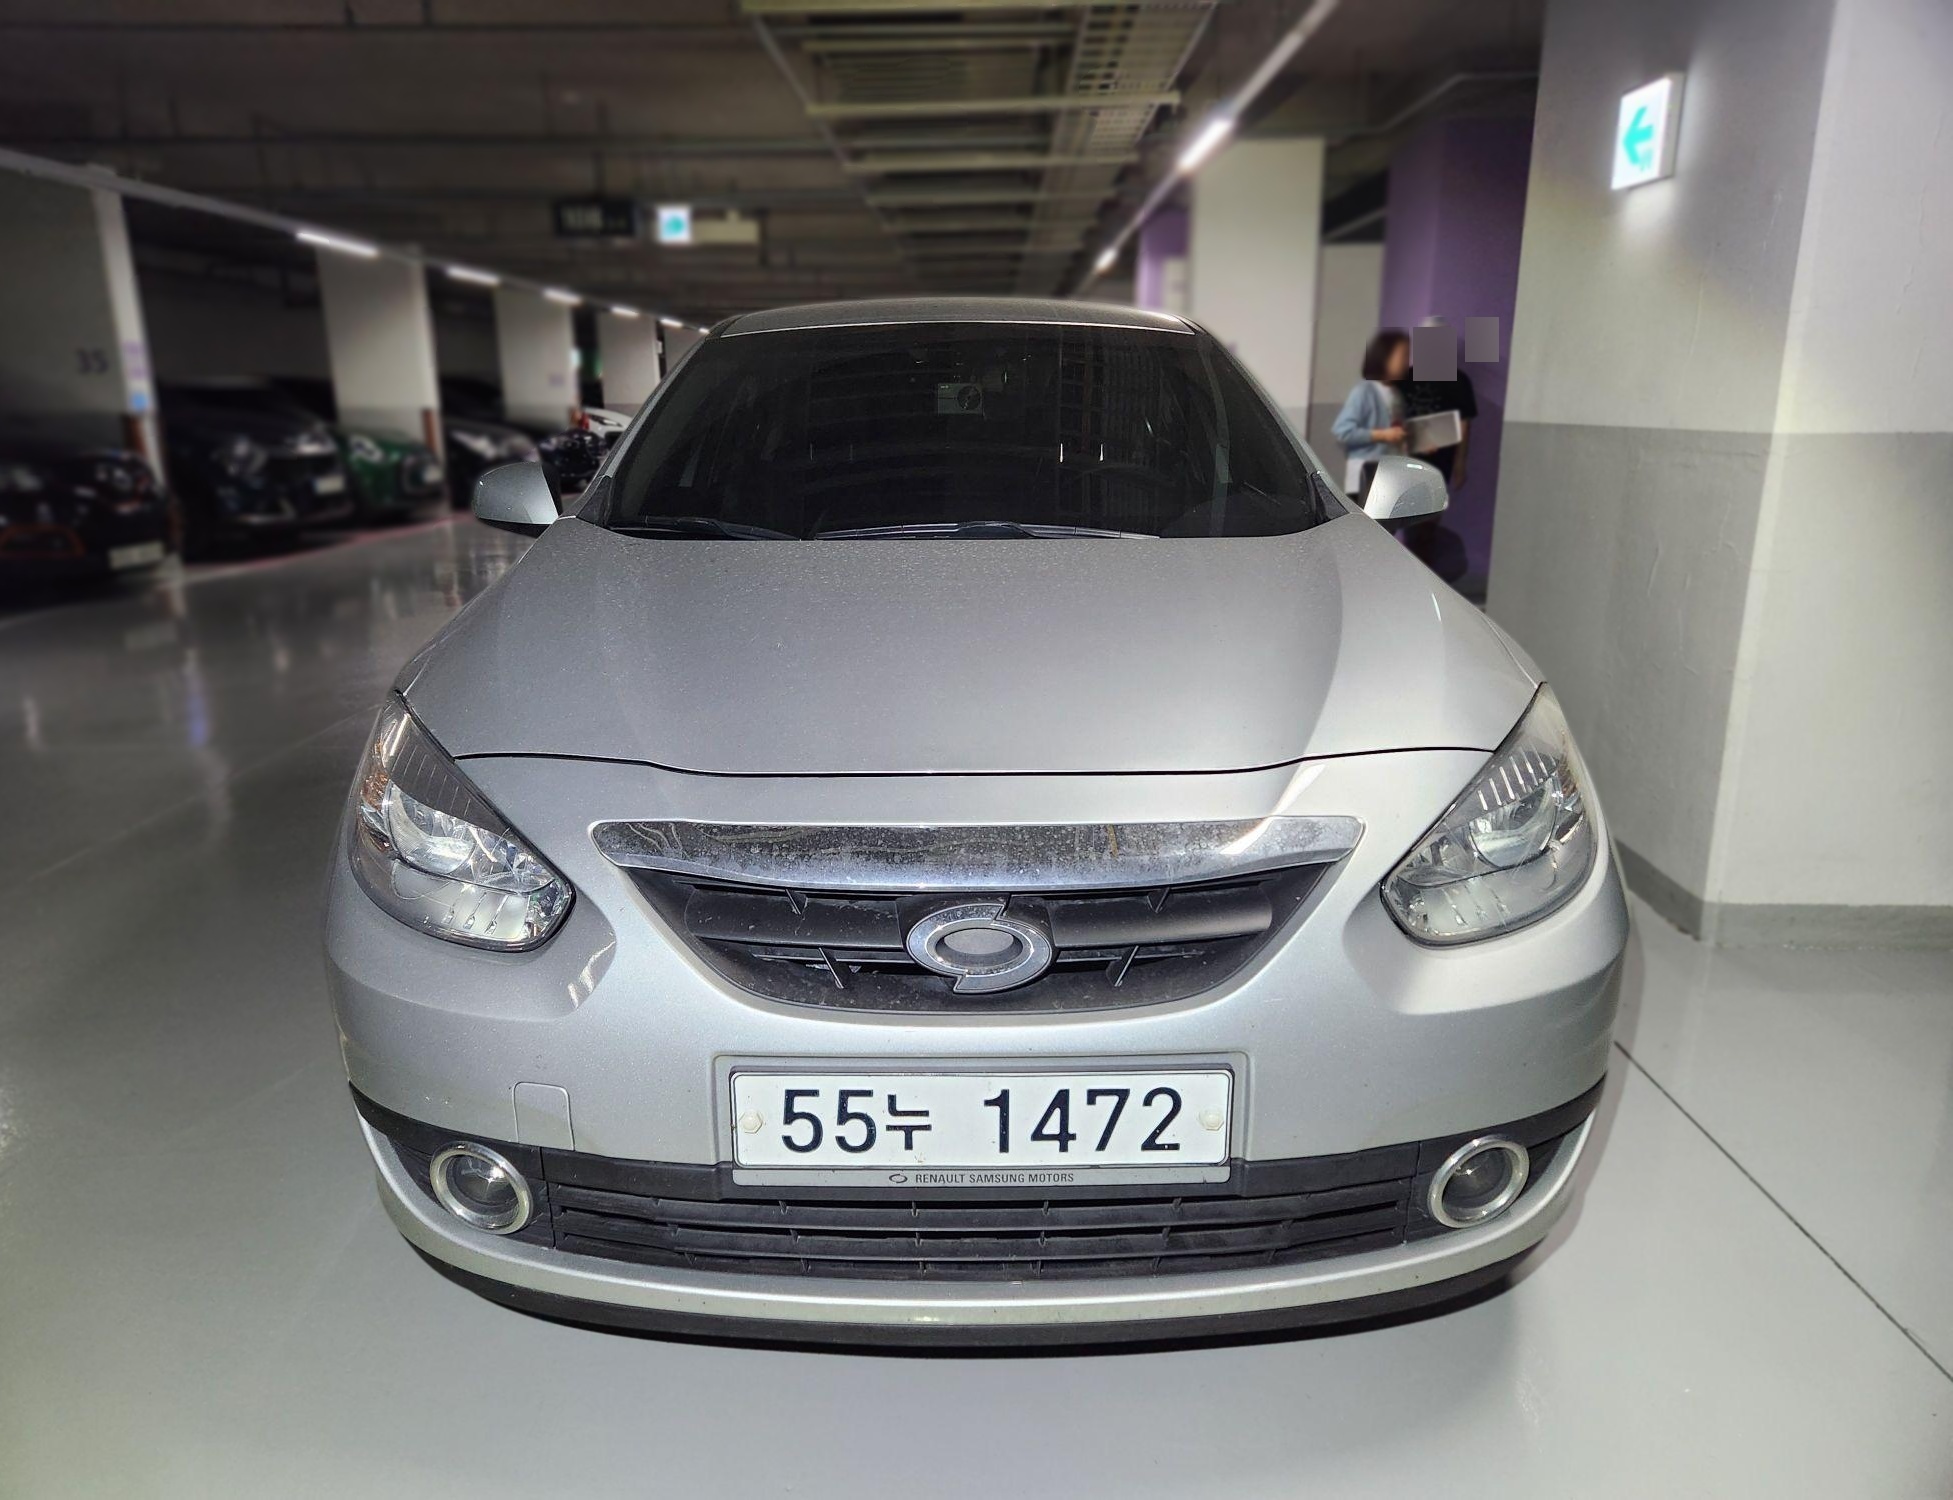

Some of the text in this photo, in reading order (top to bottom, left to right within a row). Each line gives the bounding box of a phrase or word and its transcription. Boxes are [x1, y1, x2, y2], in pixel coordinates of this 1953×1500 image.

[782, 1087, 1182, 1153] 55누 1472
[915, 1172, 1074, 1184] RENAULT SAMSUNG MOTORS
